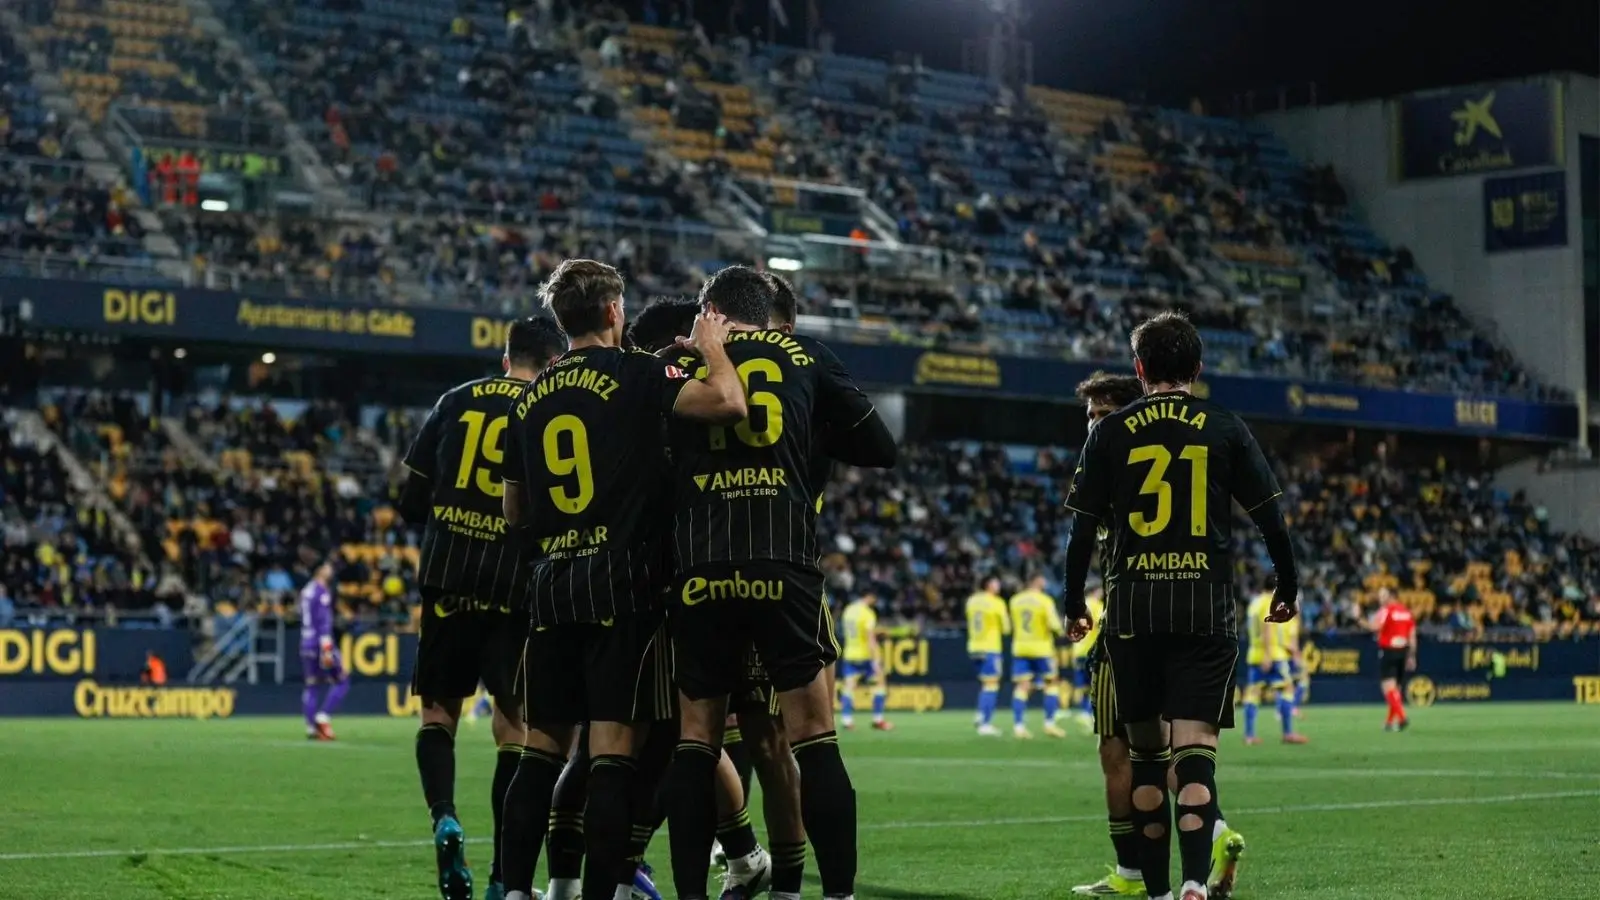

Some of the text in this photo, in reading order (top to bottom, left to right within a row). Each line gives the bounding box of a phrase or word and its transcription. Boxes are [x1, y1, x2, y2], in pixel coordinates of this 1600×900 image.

[103, 290, 176, 324] DIGI
[1124, 402, 1207, 434] PINILLA
[455, 410, 508, 496] 19
[542, 414, 594, 514] 9
[710, 467, 787, 491] AMBAR
[721, 488, 778, 500] TRIPLE ZERO
[1127, 444, 1209, 538] 31
[444, 507, 507, 534] AMBAR
[474, 529, 496, 541] ZERO
[576, 546, 599, 557] ZERO
[1136, 552, 1210, 571] AMBAR
[682, 570, 784, 606] embou
[1144, 571, 1201, 580] TRIPLE ZERO
[0, 629, 96, 675] DIGI
[339, 633, 399, 677] IGI
[883, 639, 929, 676] IGI
[74, 680, 236, 719] Cruzcampo
